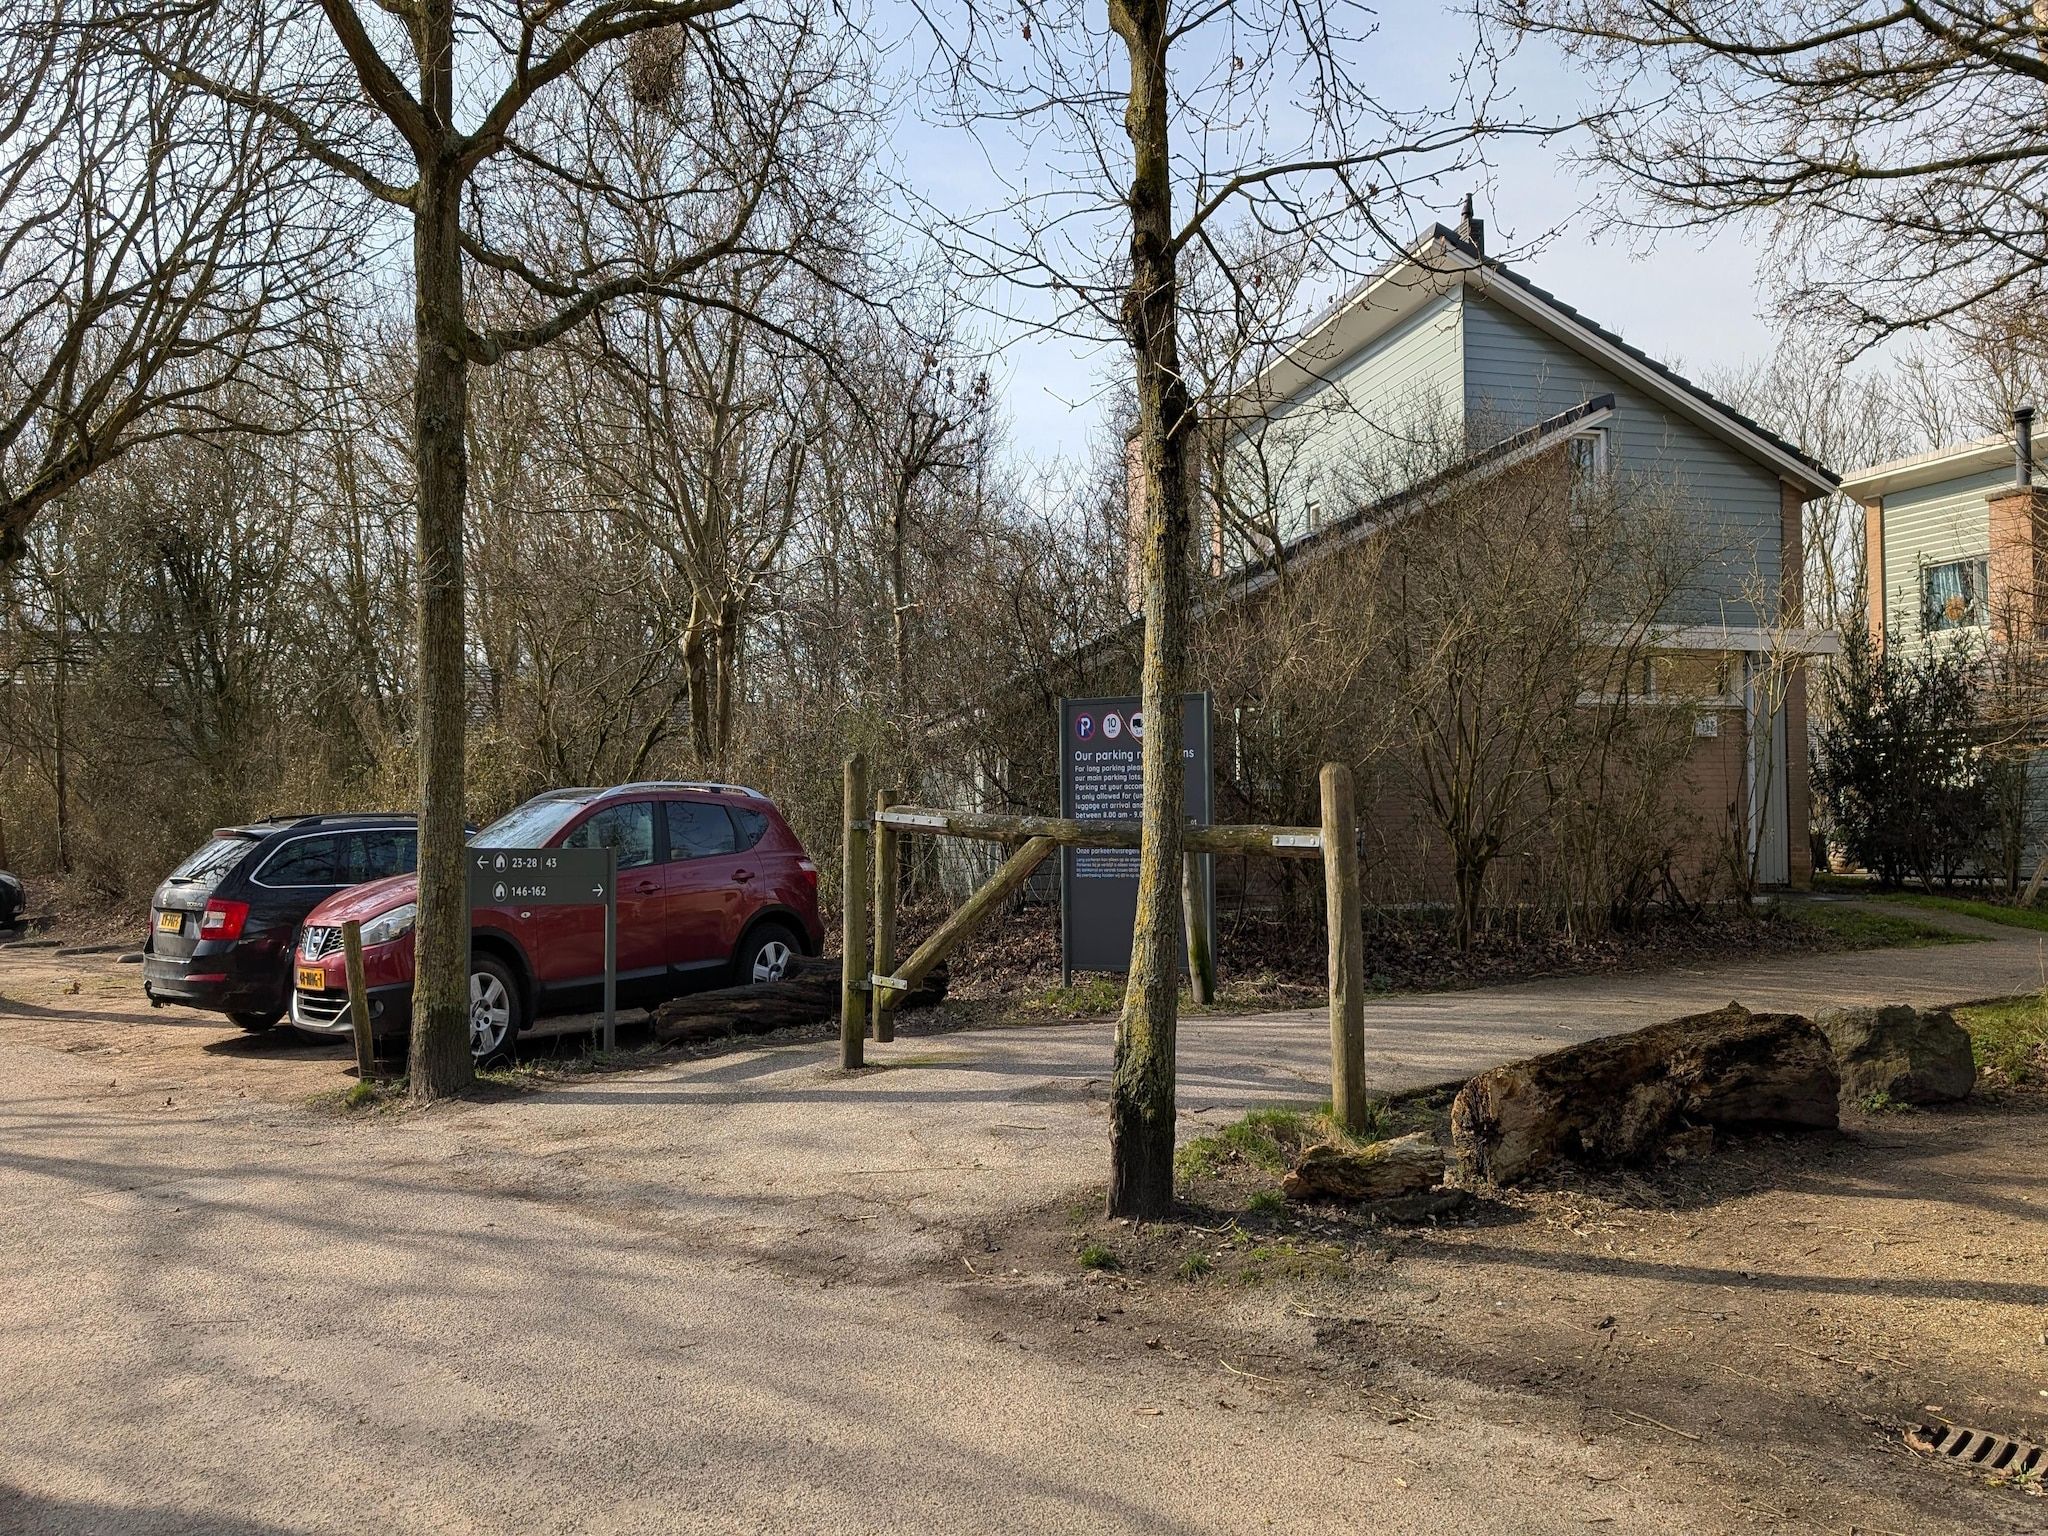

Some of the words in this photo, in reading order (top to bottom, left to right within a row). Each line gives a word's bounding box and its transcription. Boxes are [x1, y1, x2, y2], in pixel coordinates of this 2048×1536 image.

[1107, 718, 1117, 728] 10
[1075, 750, 1093, 761] Our
[1095, 749, 1134, 763] parking
[1075, 765, 1086, 773] For
[1086, 765, 1100, 773] long
[1101, 765, 1126, 773] parking
[1103, 774, 1128, 782] parking
[1075, 784, 1099, 792] Parking
[1081, 793, 1095, 801] only
[1096, 792, 1120, 800] allowed
[1075, 803, 1100, 811] luggage
[511, 857, 537, 868] 23-28
[545, 857, 557, 868] 43
[511, 886, 547, 896] 146-162
